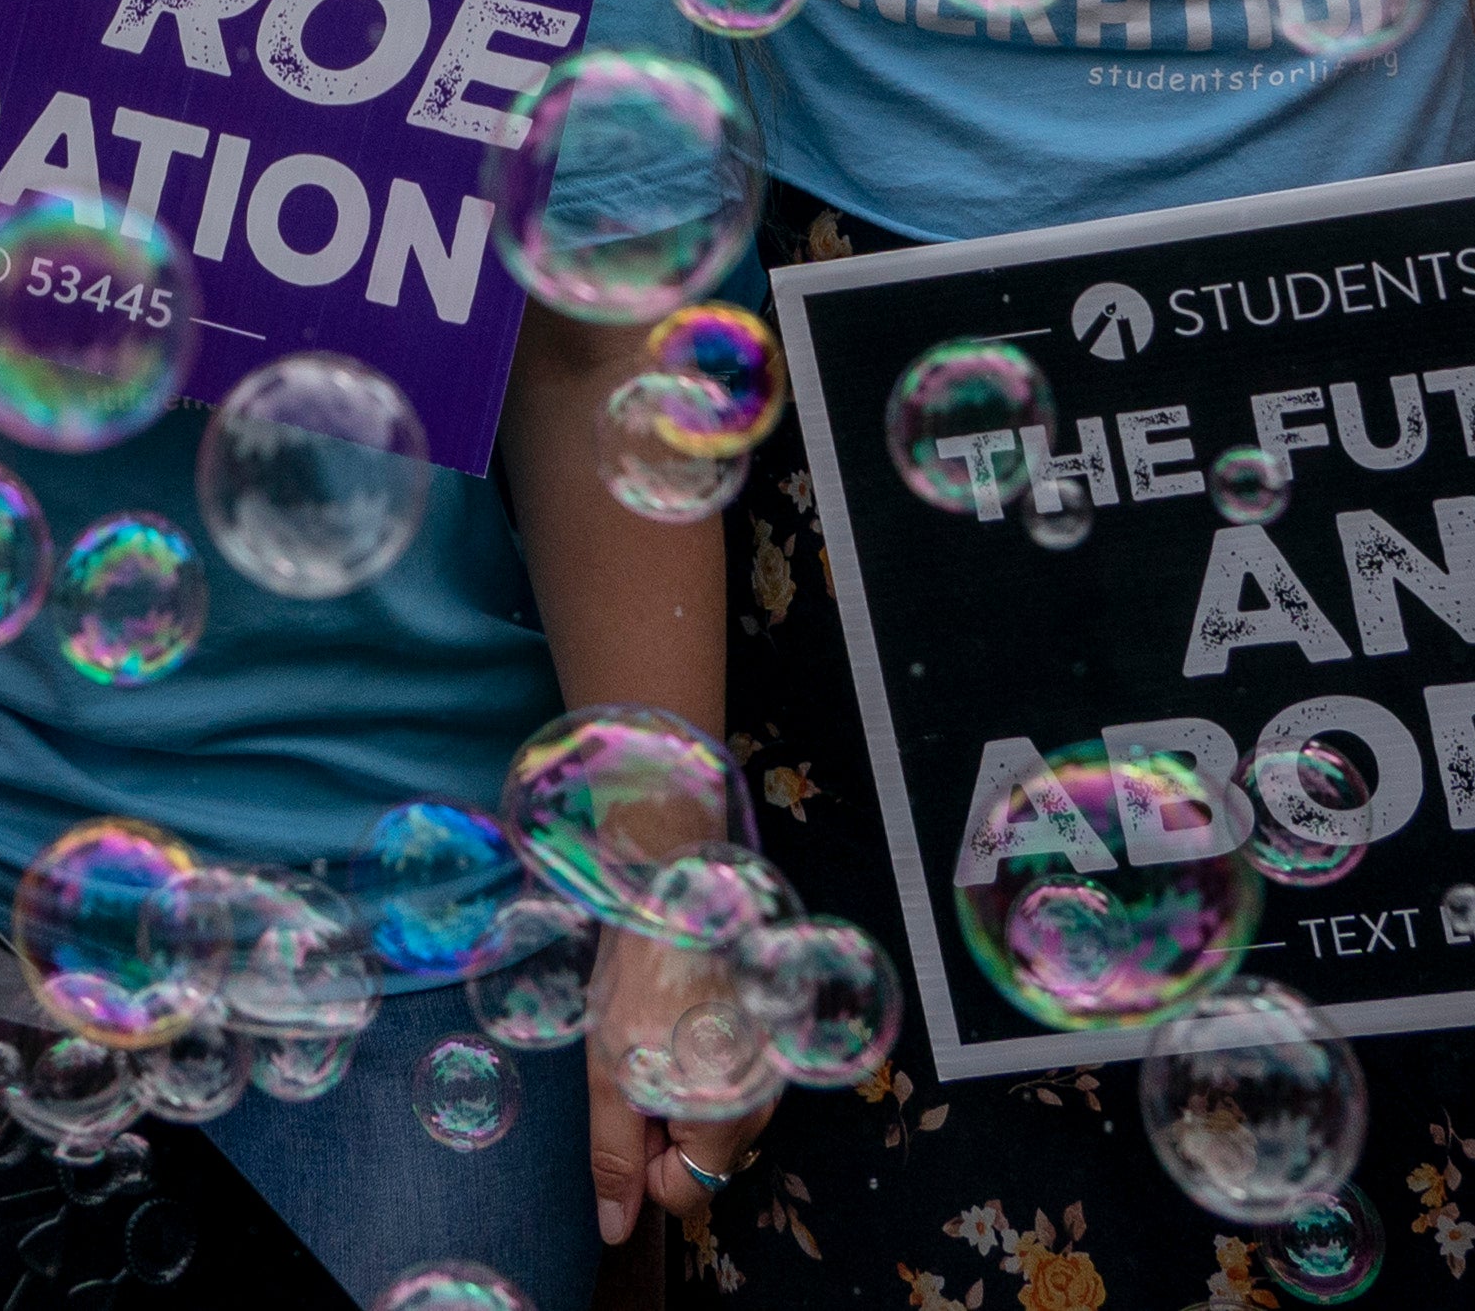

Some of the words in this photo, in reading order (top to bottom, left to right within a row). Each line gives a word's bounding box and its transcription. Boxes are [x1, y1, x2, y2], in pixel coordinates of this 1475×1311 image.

[25, 258, 175, 330] 53445
[935, 403, 1204, 524] THE
[1297, 907, 1425, 959] TEXT
